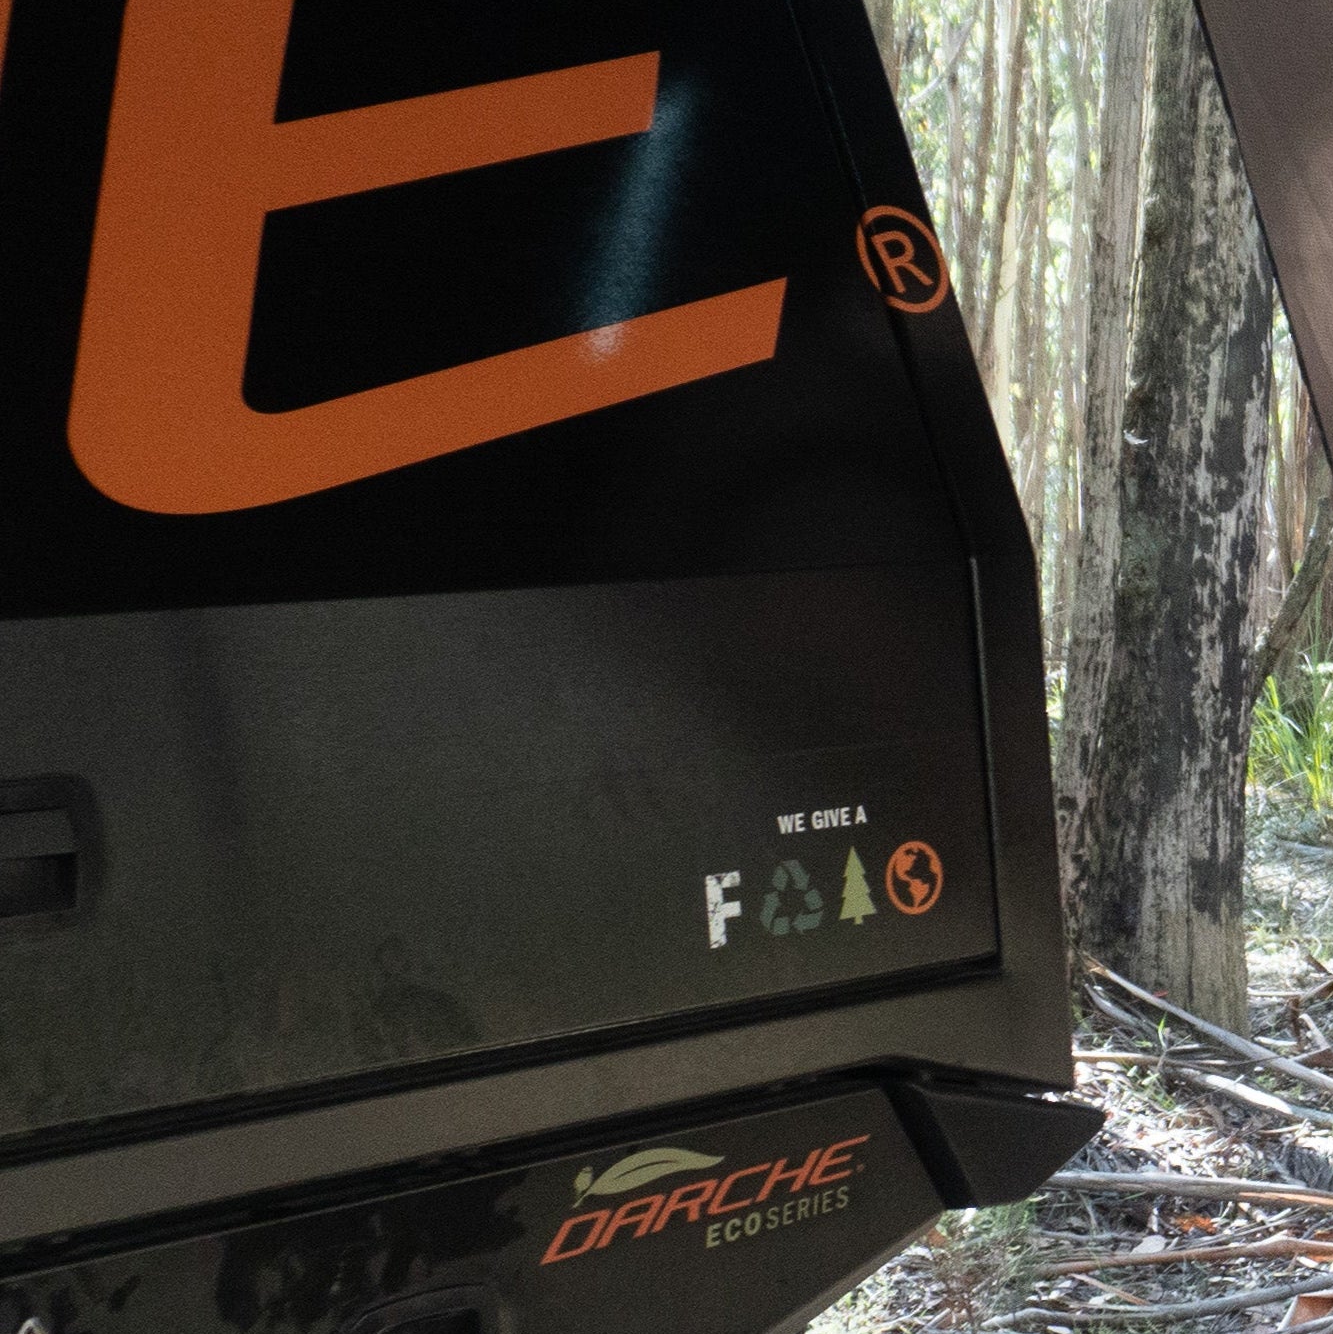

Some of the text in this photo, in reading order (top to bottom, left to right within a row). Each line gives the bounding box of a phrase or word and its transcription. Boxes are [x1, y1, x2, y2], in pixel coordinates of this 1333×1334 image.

[777, 804, 868, 835] WE GIVE A
[704, 870, 743, 950] F
[540, 1133, 871, 1266] DARCHE
